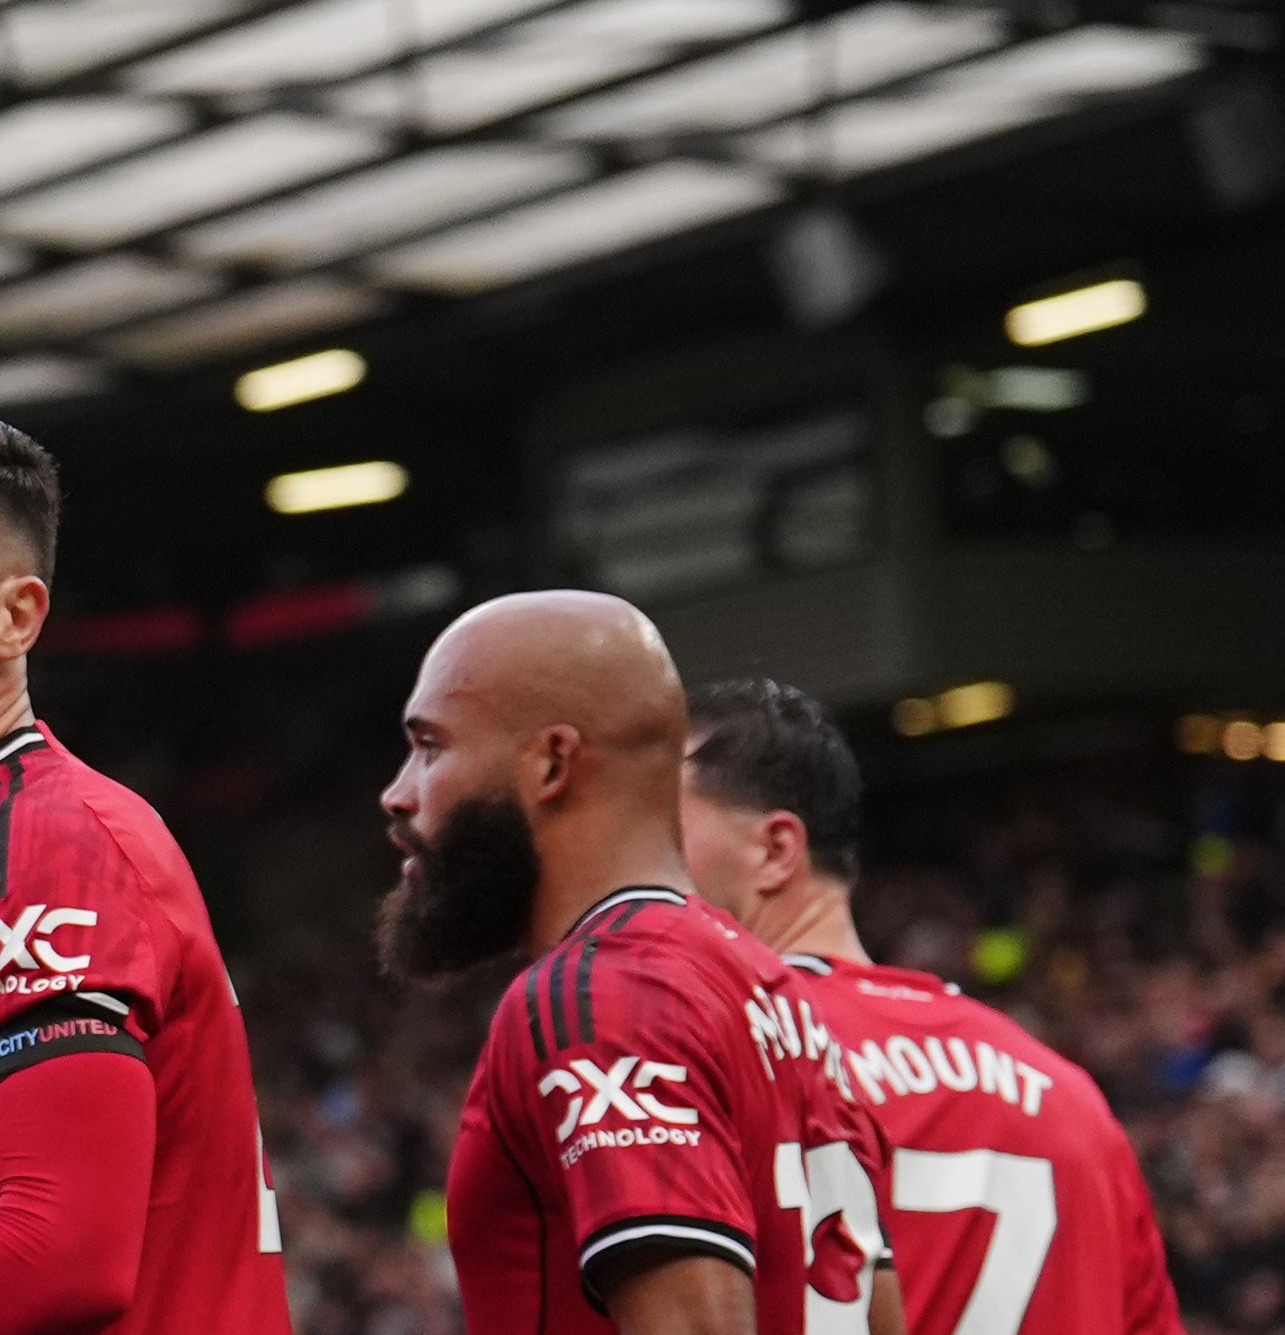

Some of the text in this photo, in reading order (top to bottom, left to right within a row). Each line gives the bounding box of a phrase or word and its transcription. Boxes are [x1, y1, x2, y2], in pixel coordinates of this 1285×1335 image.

[537, 1055, 699, 1144] DXC
[847, 1034, 1054, 1117] MOUNT
[559, 1125, 701, 1171] TECHNOLOGY
